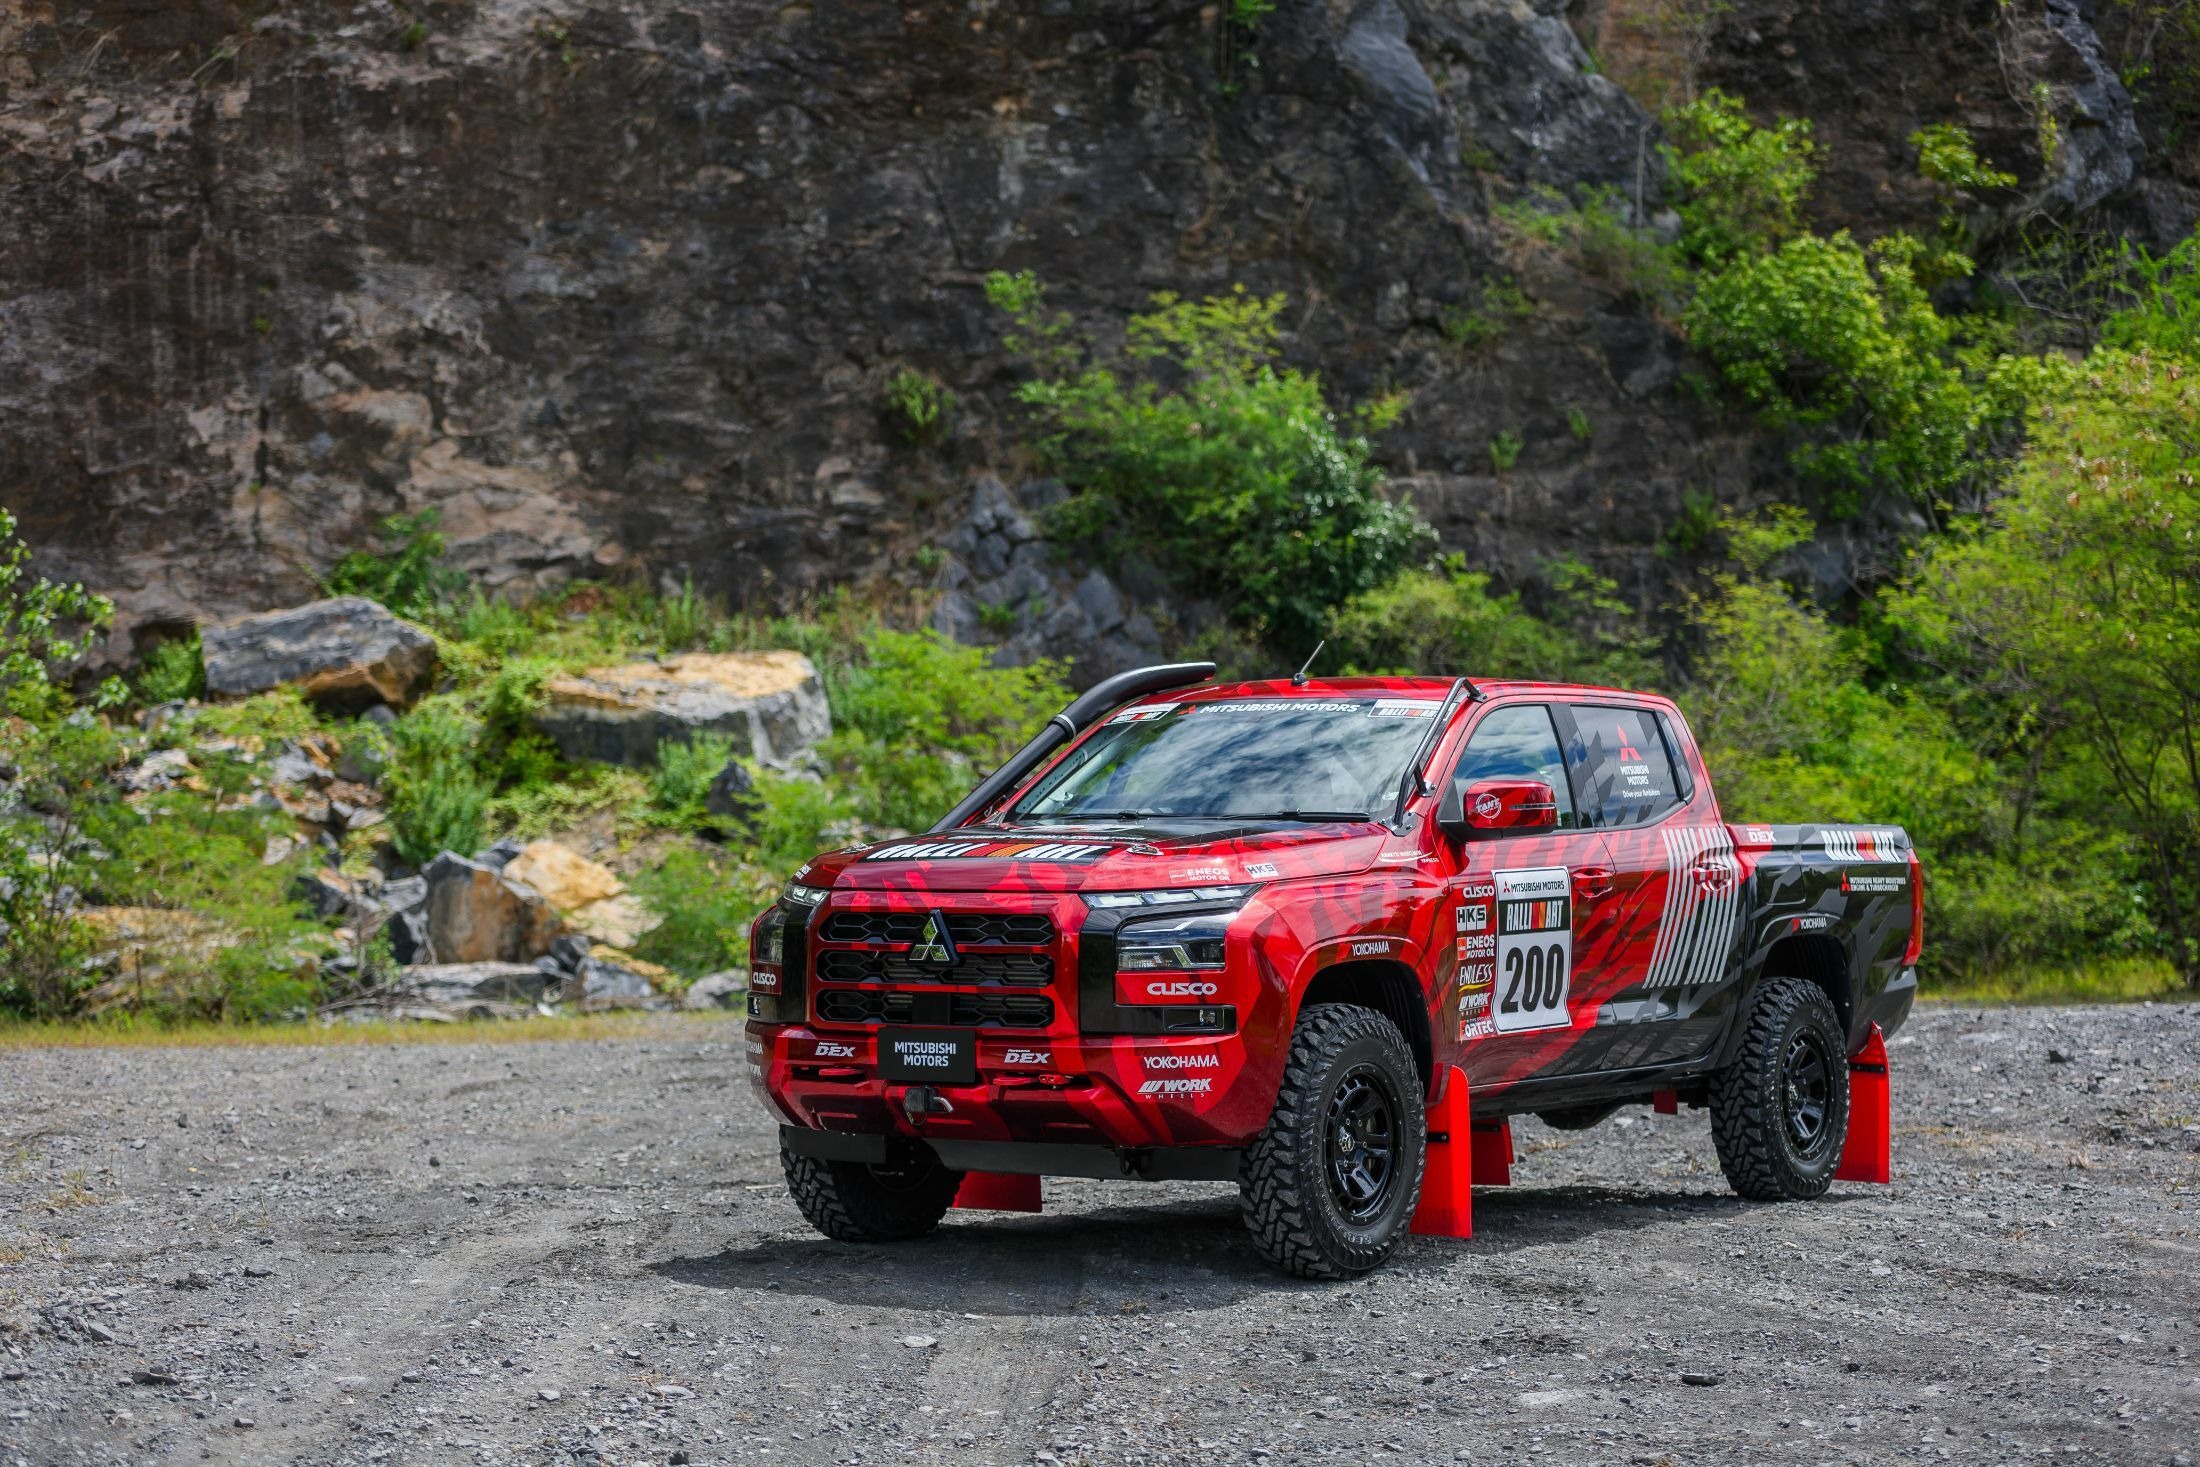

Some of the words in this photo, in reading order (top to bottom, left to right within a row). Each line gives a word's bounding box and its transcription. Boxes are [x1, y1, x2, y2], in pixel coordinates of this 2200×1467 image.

[1199, 703, 1290, 714] MITSUBISHI
[1292, 702, 1361, 713] MOTORS
[1747, 831, 1777, 843] DEX
[1187, 867, 1230, 876] ENEOS
[1248, 864, 1276, 875] HKS
[1463, 885, 1495, 898] CUSCO
[1510, 882, 1541, 893] MITSUBISHI
[1542, 881, 1565, 891] MOTORS
[1457, 906, 1486, 925] HKS
[1466, 934, 1495, 949] ENEOS
[1352, 941, 1390, 957] YOKOHAMA
[1466, 949, 1486, 959] MOTOR
[1486, 948, 1495, 957] OIL
[753, 971, 777, 986] CUSCO
[1460, 963, 1494, 986] ENDLESS
[1501, 943, 1565, 1014] 200
[1146, 982, 1218, 996] CUSCO
[815, 1046, 856, 1058] DEX
[894, 1041, 957, 1055] MITSUBISHI
[903, 1054, 949, 1067] MOTORS
[1004, 1052, 1051, 1064] DEX
[1143, 1054, 1220, 1069] YOKOHAMA
[1164, 1078, 1213, 1093] WORK
[1144, 1092, 1206, 1100] WHEELS
